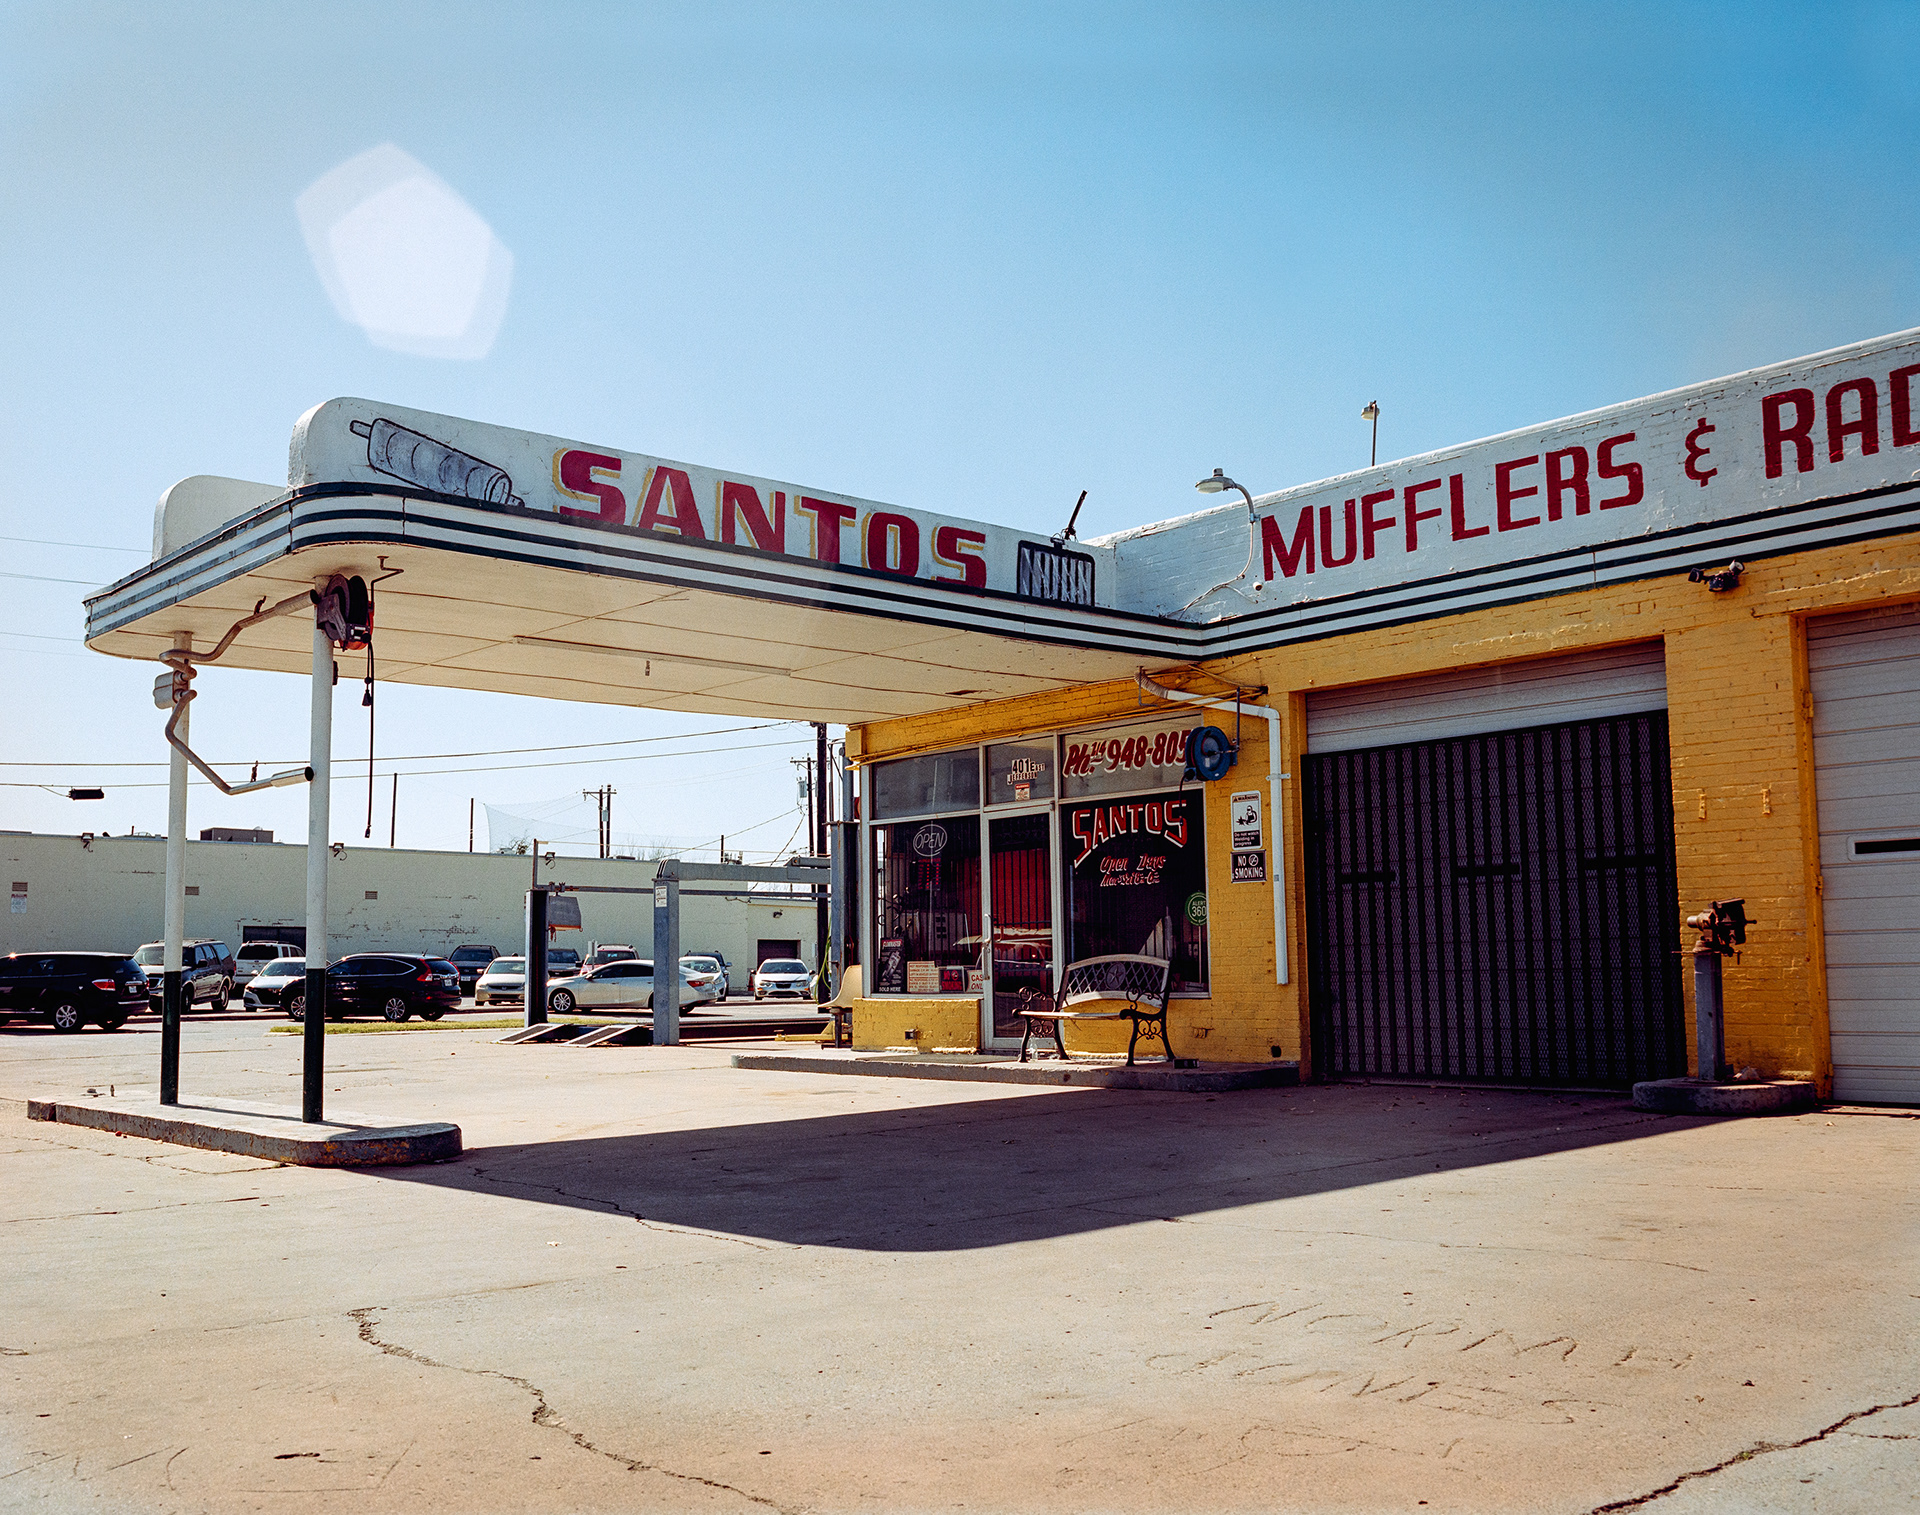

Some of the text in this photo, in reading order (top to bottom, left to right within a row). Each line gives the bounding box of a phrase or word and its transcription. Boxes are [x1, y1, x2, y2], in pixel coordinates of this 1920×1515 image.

[1262, 431, 1645, 582] MUFFLERS
[552, 447, 987, 590] SANTOS
[1104, 729, 1192, 773] 948-805
[1012, 758, 1030, 773] 401
[1007, 771, 1038, 785] JEFFERSON
[915, 832, 944, 849] OPEN
[1072, 800, 1188, 868] SANTOS
[1100, 856, 1128, 874] Open
[1237, 855, 1247, 867] NO
[1235, 866, 1264, 879] SMOKING
[1191, 906, 1206, 917] 360
[971, 974, 983, 982] CAS
